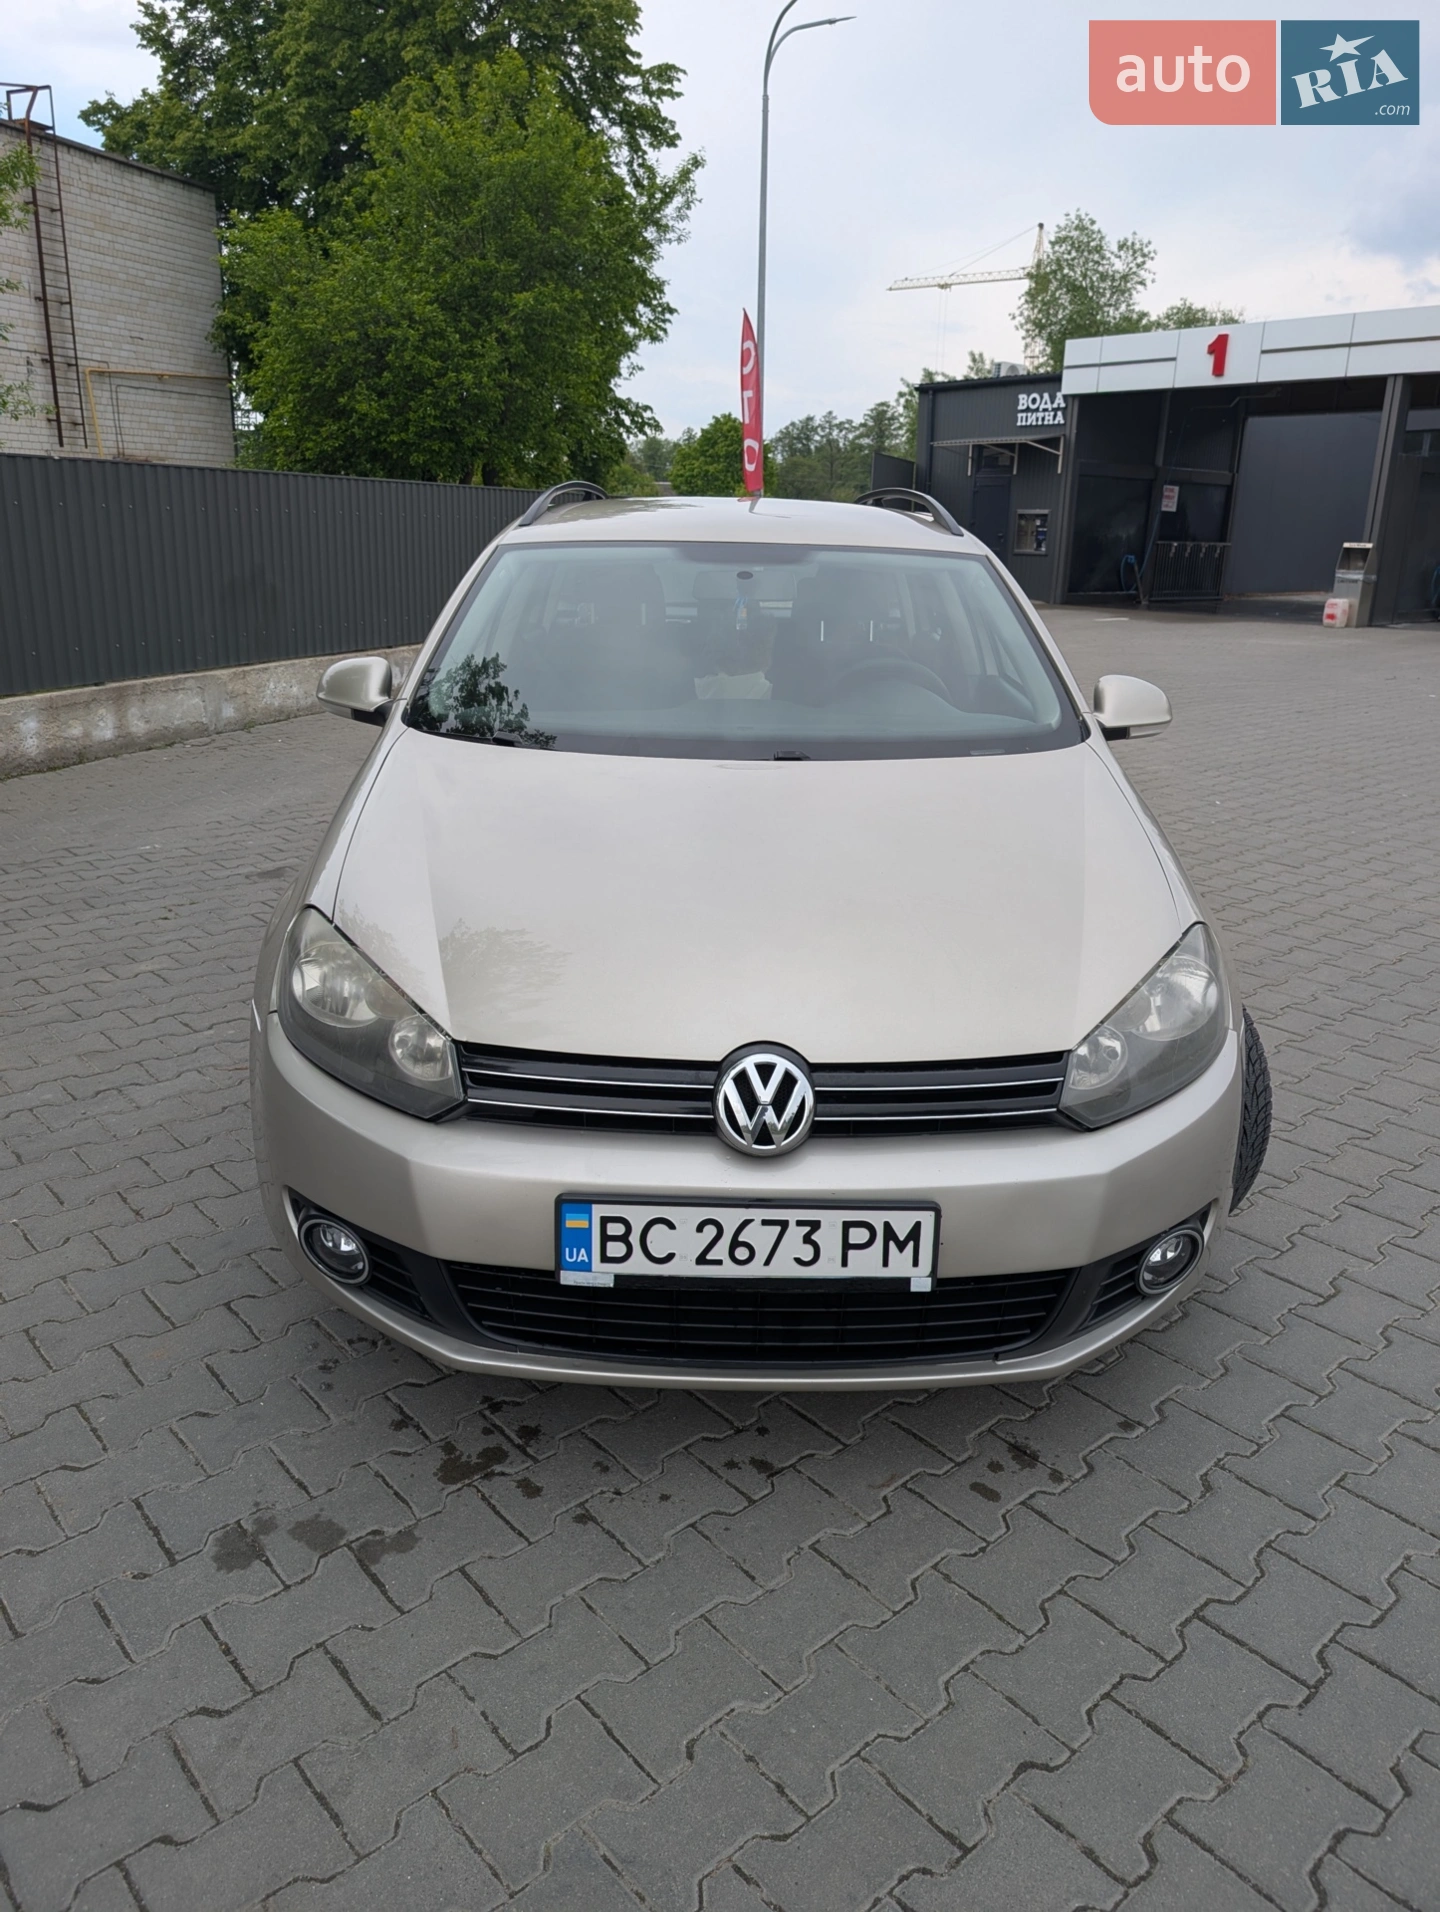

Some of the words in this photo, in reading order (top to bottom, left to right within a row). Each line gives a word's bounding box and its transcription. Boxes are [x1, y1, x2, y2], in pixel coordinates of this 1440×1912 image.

[1207, 333, 1229, 377] 1
[1017, 391, 1066, 411] ВОДА
[1016, 410, 1065, 426] ПИТНА
[599, 1215, 677, 1265] BC
[695, 1217, 822, 1268] 2673
[841, 1220, 922, 1268] PM
[565, 1247, 589, 1263] UA
